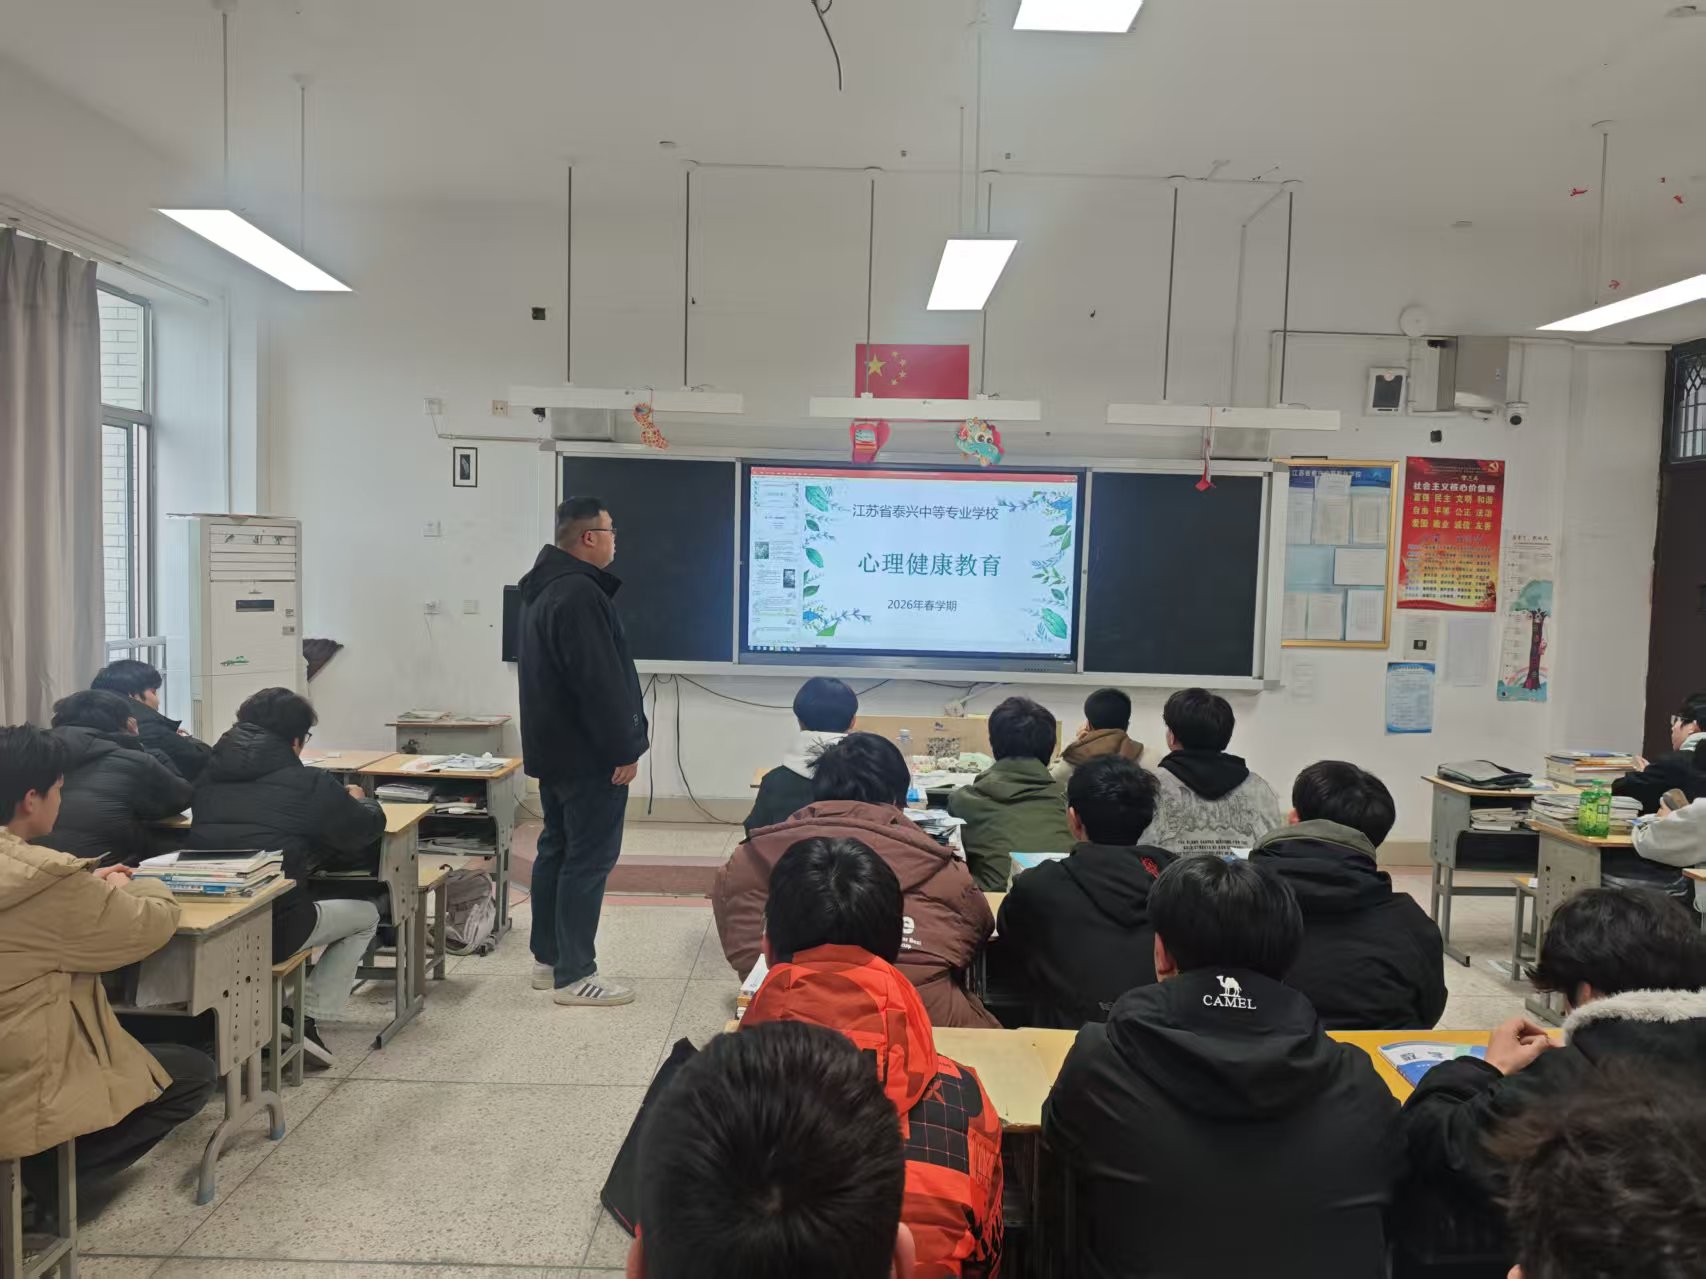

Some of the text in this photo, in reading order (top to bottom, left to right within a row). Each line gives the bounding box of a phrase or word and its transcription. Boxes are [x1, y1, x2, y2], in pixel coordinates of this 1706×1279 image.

[1413, 482, 1496, 493] 社会主义核心价值观
[1434, 493, 1451, 503] 民主
[1455, 494, 1473, 504] 文明
[1477, 495, 1494, 505] 和谐
[852, 503, 1000, 521] 江苏省泰兴中等专业学校
[1455, 507, 1472, 517] 公正
[858, 552, 1001, 577] 心理健康教育
[887, 599, 958, 612] 2026年春学期
[1202, 994, 1257, 1010] CAMEL
